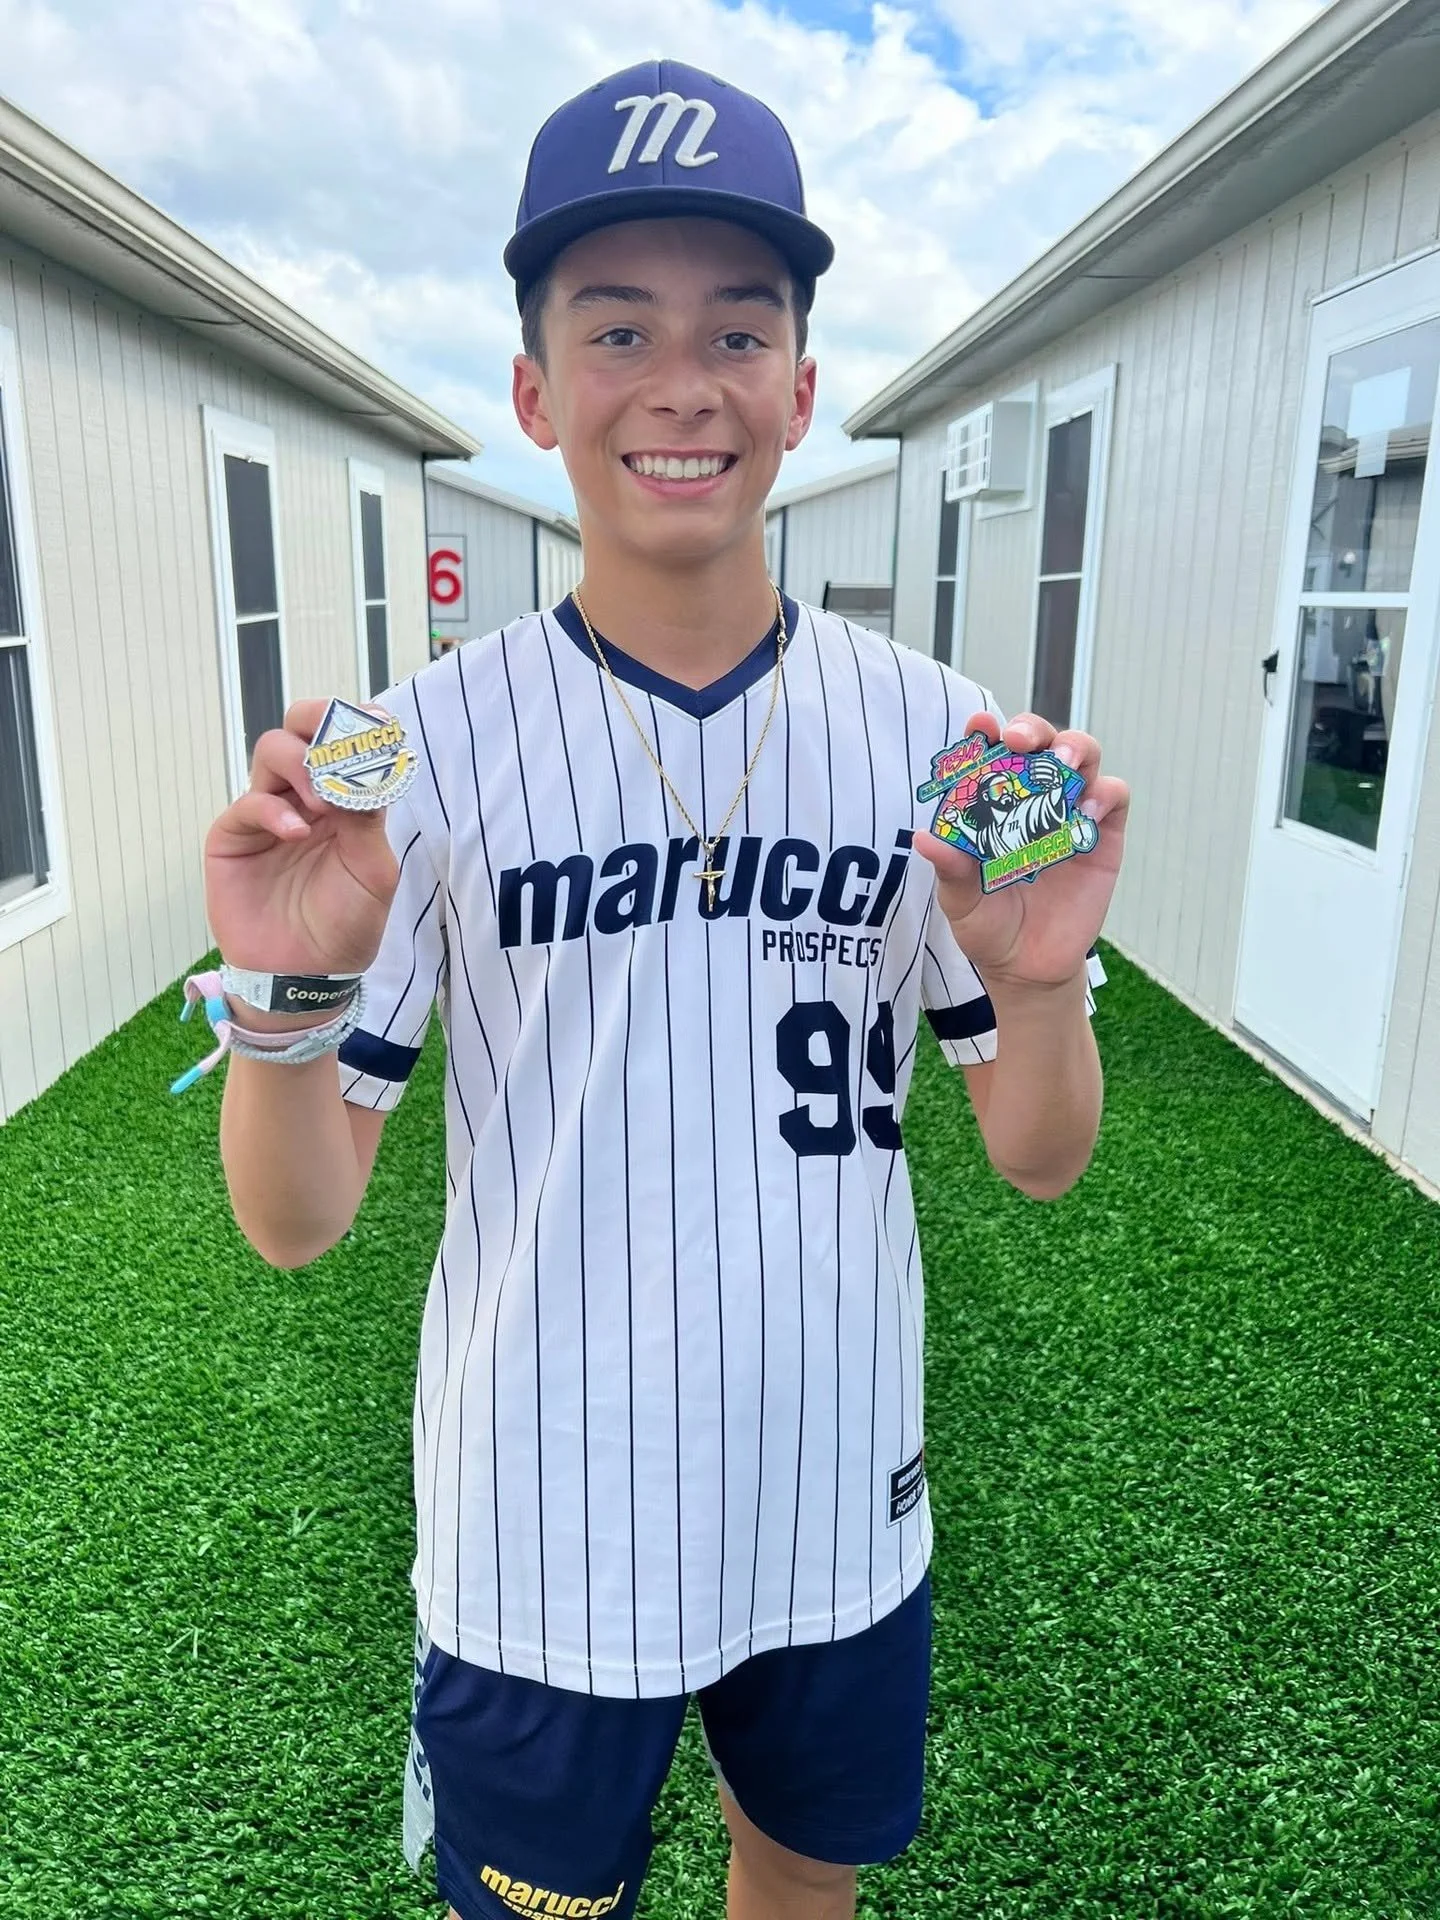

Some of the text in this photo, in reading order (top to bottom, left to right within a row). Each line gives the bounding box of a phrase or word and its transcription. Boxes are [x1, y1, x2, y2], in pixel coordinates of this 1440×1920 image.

[429, 549, 463, 605] 6
[309, 716, 403, 769] marucci
[985, 822, 1072, 881] marucci
[499, 828, 915, 949] marucci
[286, 986, 349, 1004] Cooper
[775, 1000, 904, 1157] 99
[480, 1864, 625, 1918] marucci
